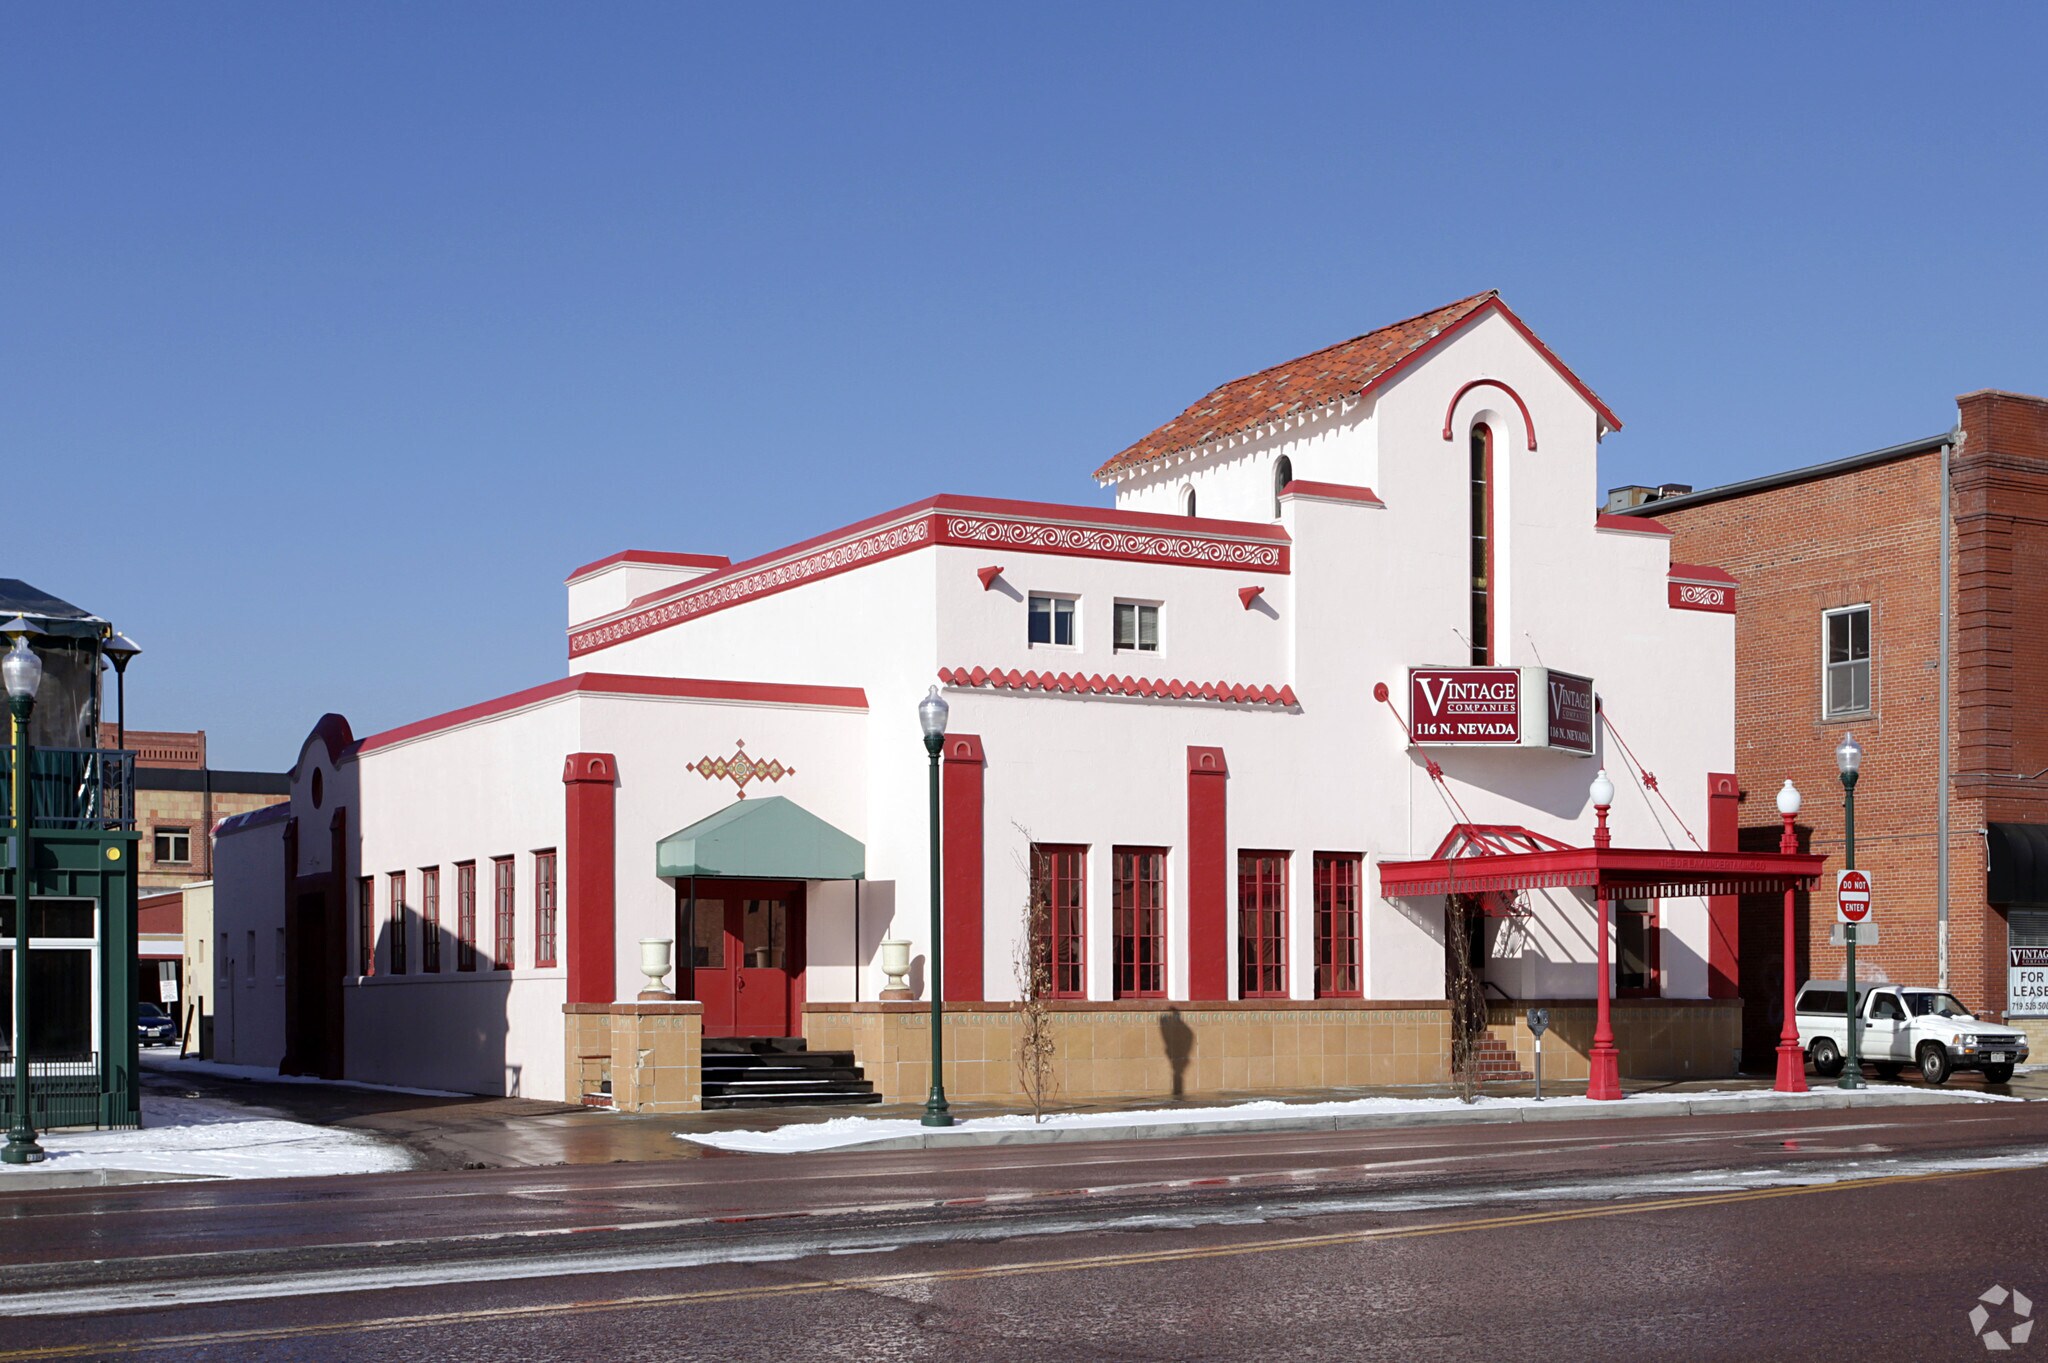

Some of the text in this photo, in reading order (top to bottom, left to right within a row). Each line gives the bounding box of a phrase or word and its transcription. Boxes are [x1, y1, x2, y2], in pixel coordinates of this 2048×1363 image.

[1416, 678, 1516, 716] VINTAGE
[1550, 682, 1591, 720] VINTAGE
[1447, 704, 1516, 712] COMPANIES
[1417, 723, 1516, 735] 116 N. NEVADA
[1550, 726, 1559, 738] 116
[1567, 729, 1590, 743] NEVADA
[1843, 881, 1866, 890] DO NOT
[1845, 903, 1864, 912] ENTER
[2020, 971, 2044, 983] FOR
[2013, 986, 2048, 997] LEASE
